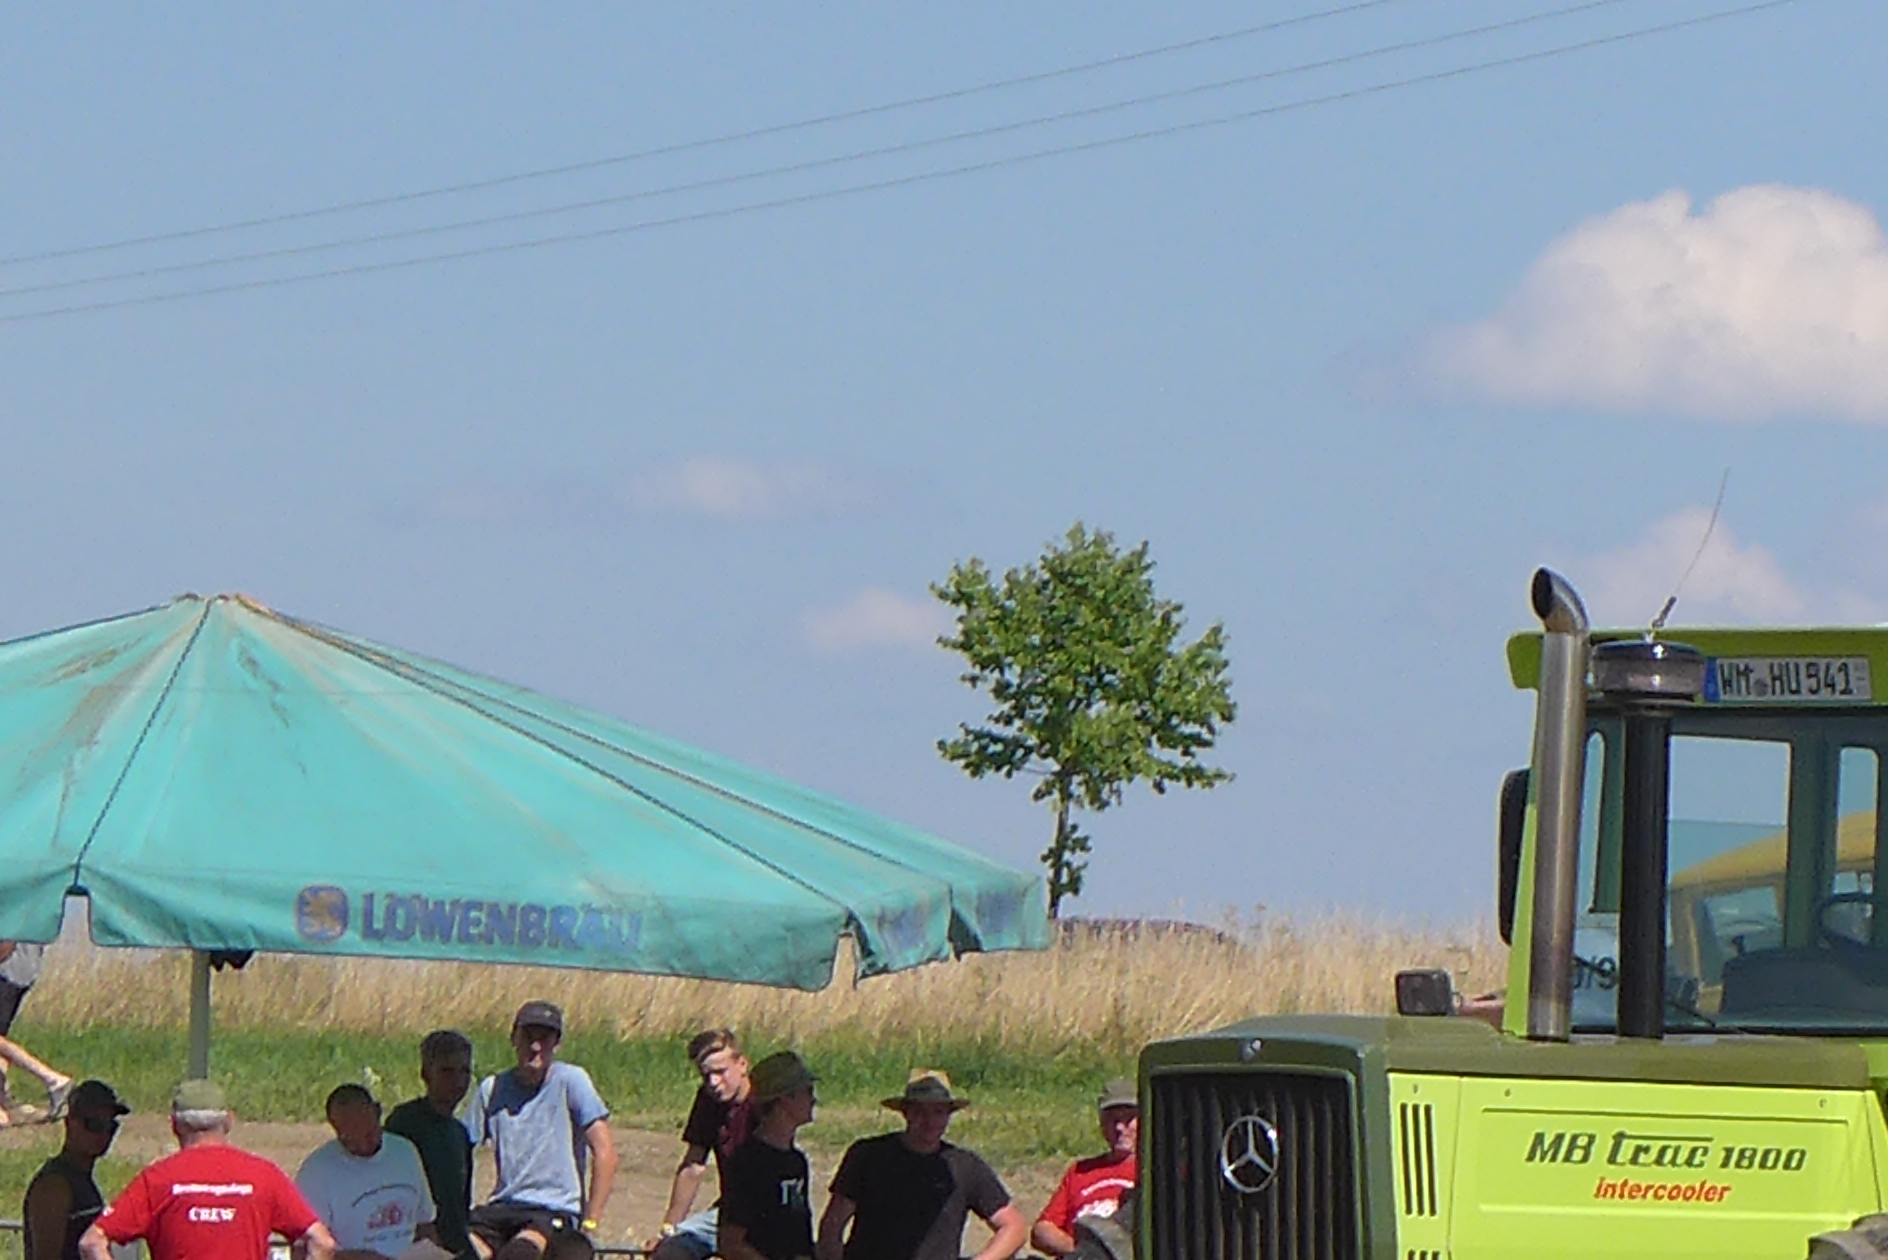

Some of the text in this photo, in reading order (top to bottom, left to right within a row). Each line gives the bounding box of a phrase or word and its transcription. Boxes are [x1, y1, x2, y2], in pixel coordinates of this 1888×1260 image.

[1719, 662, 1854, 695] WM HU 541
[1525, 1131, 1808, 1171] MB trac 1800
[1594, 1177, 1731, 1203] intercooler
